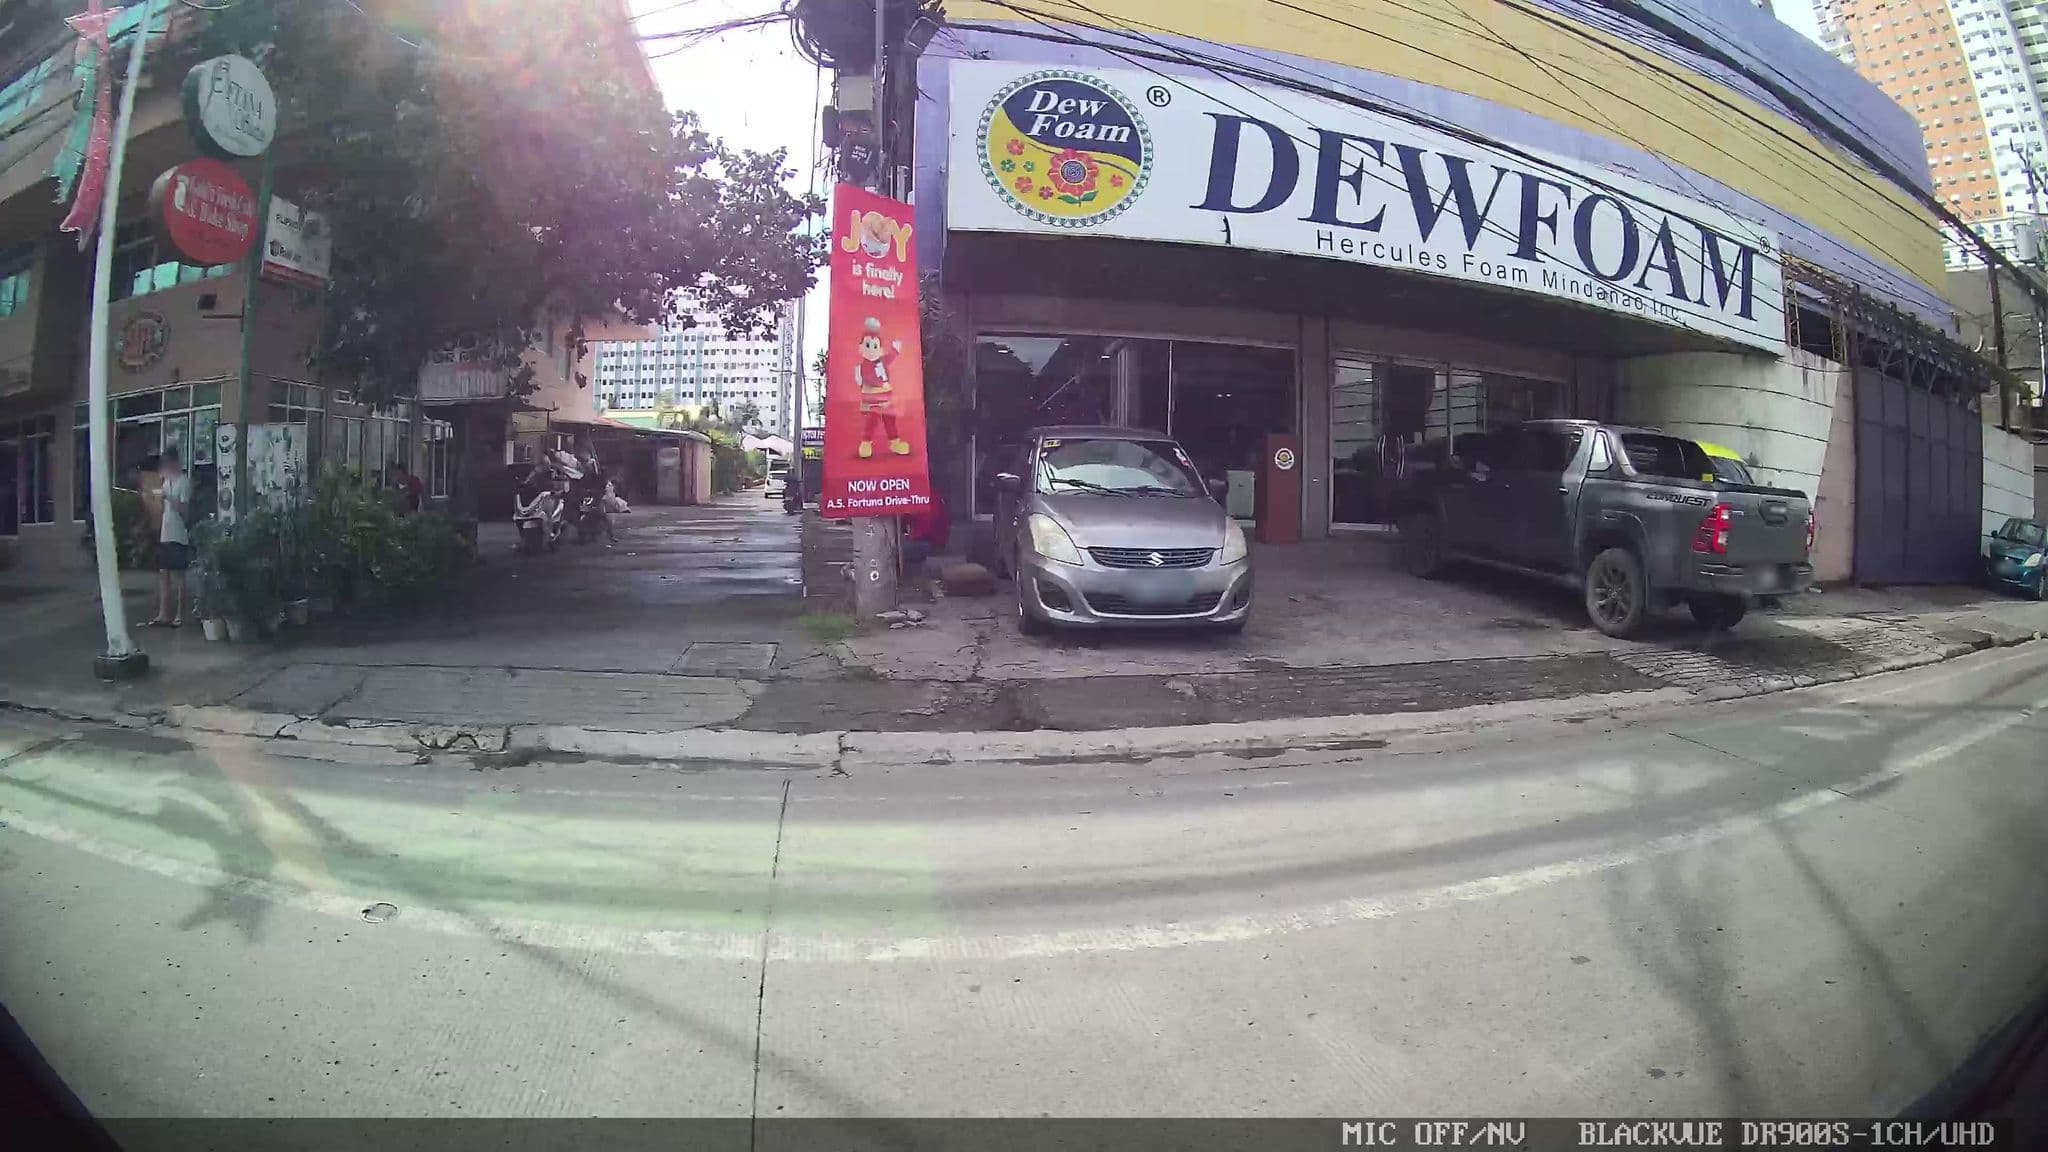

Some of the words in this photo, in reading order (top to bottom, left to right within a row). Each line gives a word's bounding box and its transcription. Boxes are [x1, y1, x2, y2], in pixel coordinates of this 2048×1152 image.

[1025, 89, 1109, 118] Dew
[1026, 113, 1131, 143] Foam
[1189, 111, 1758, 322] DEWFOAM
[841, 209, 913, 262] JOY
[1316, 229, 1447, 270] Hercules
[1463, 253, 1528, 285] Foam
[852, 259, 863, 276] is
[865, 262, 903, 287] finally
[862, 280, 896, 299] here!
[847, 480, 877, 493] NOW
[879, 478, 910, 492] OPEN
[827, 499, 846, 509] A.S.
[847, 497, 884, 508] Fortuna
[885, 494, 931, 507] Drive-Thru
